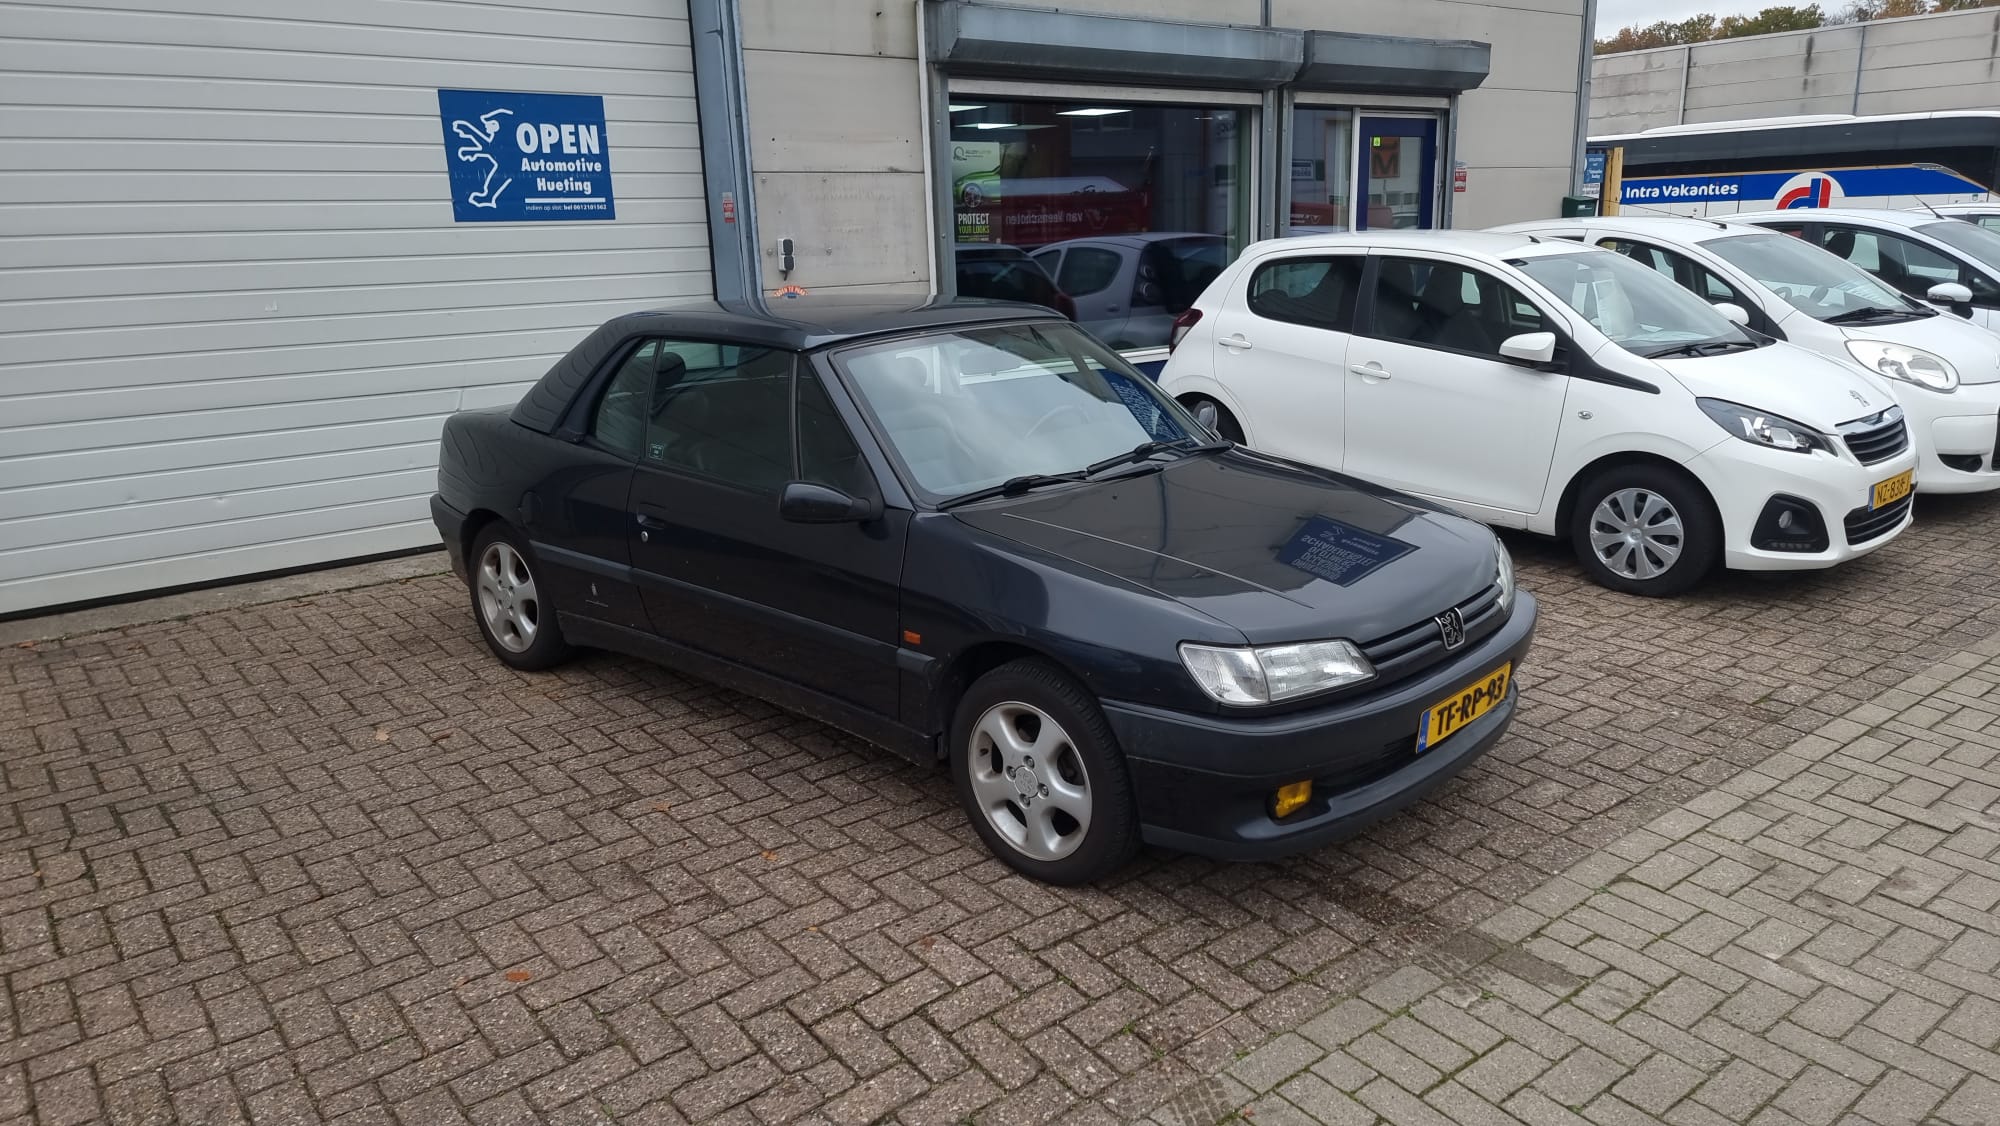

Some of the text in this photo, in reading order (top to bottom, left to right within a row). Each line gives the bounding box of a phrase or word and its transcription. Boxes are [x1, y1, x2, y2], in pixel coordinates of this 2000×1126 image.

[516, 122, 600, 154] OPEN
[521, 157, 602, 172] Automotive
[536, 177, 592, 195] Hueting
[1626, 182, 1739, 199] Intra Vakanties
[958, 213, 990, 225] PROTECT
[1437, 673, 1505, 736] TF-RP-93
